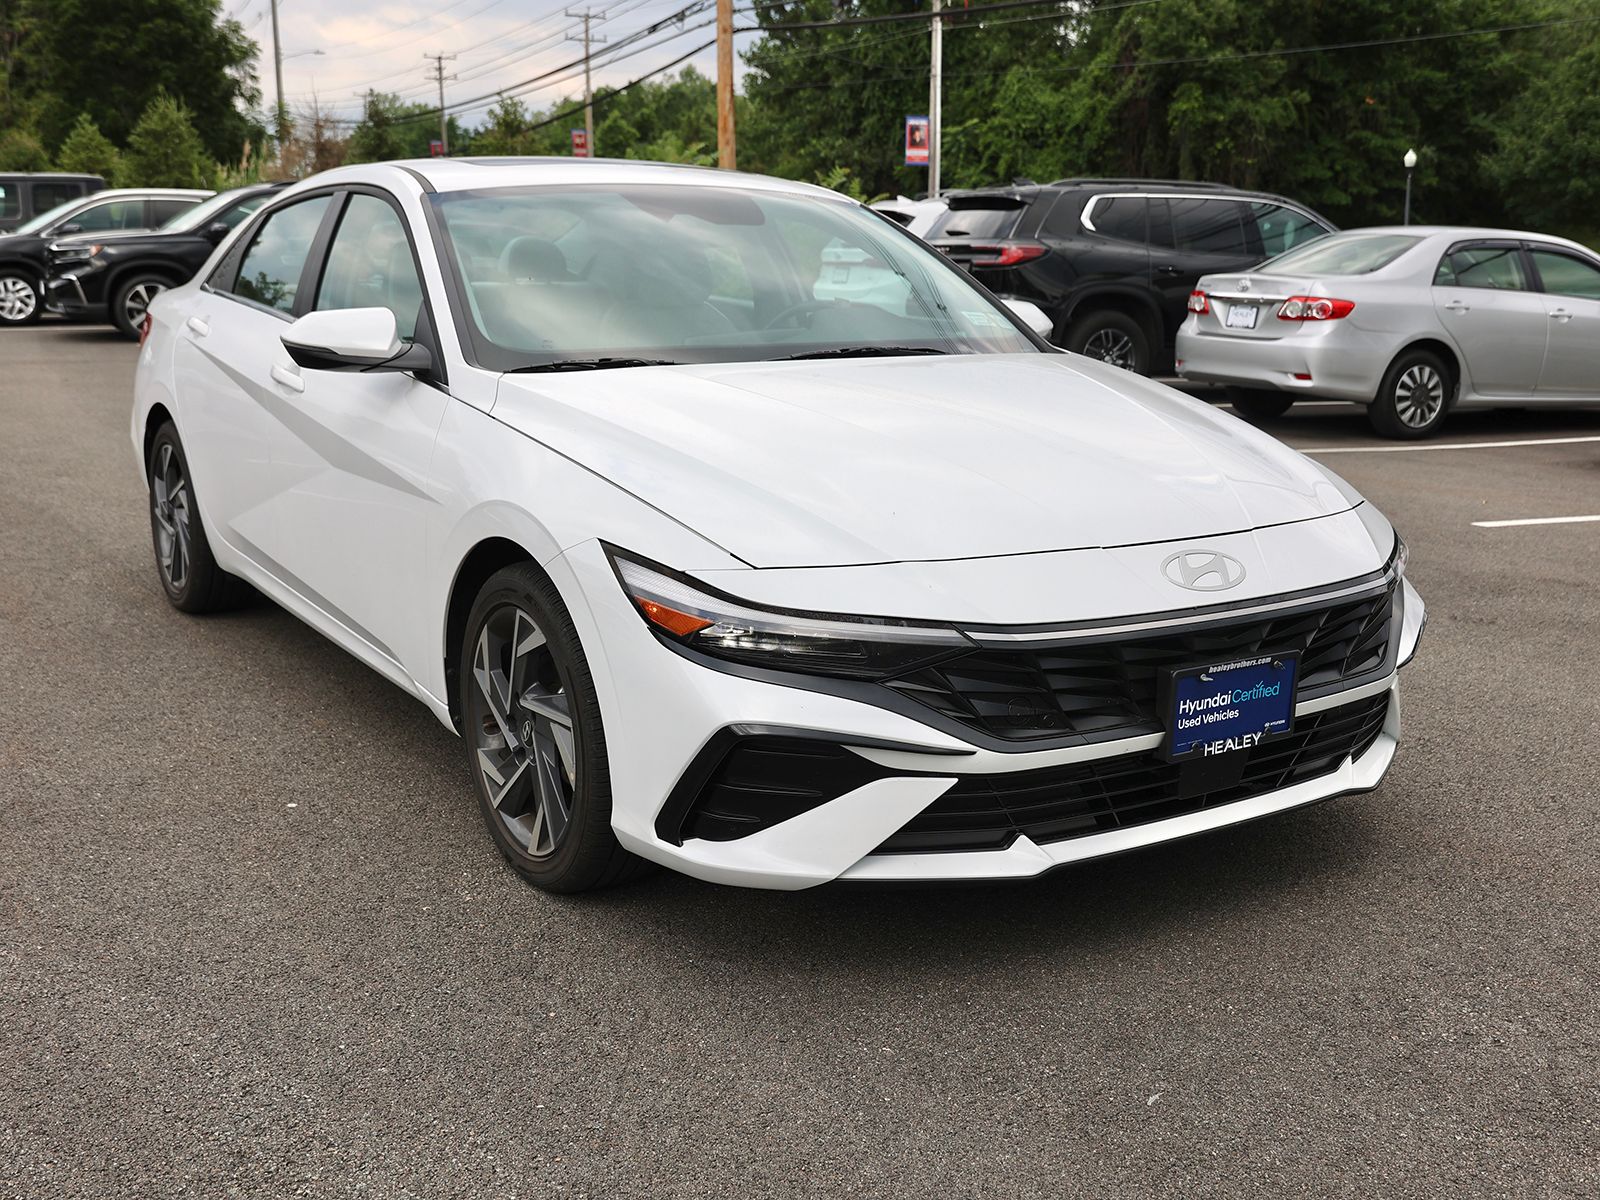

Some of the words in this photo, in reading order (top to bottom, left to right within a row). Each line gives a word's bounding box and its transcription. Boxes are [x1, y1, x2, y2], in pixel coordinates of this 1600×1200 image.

[1209, 657, 1272, 673] healeybrothers.com
[1178, 715, 1201, 729] Used
[1202, 709, 1239, 724] Vehicles
[1204, 732, 1262, 757] HEALEY
